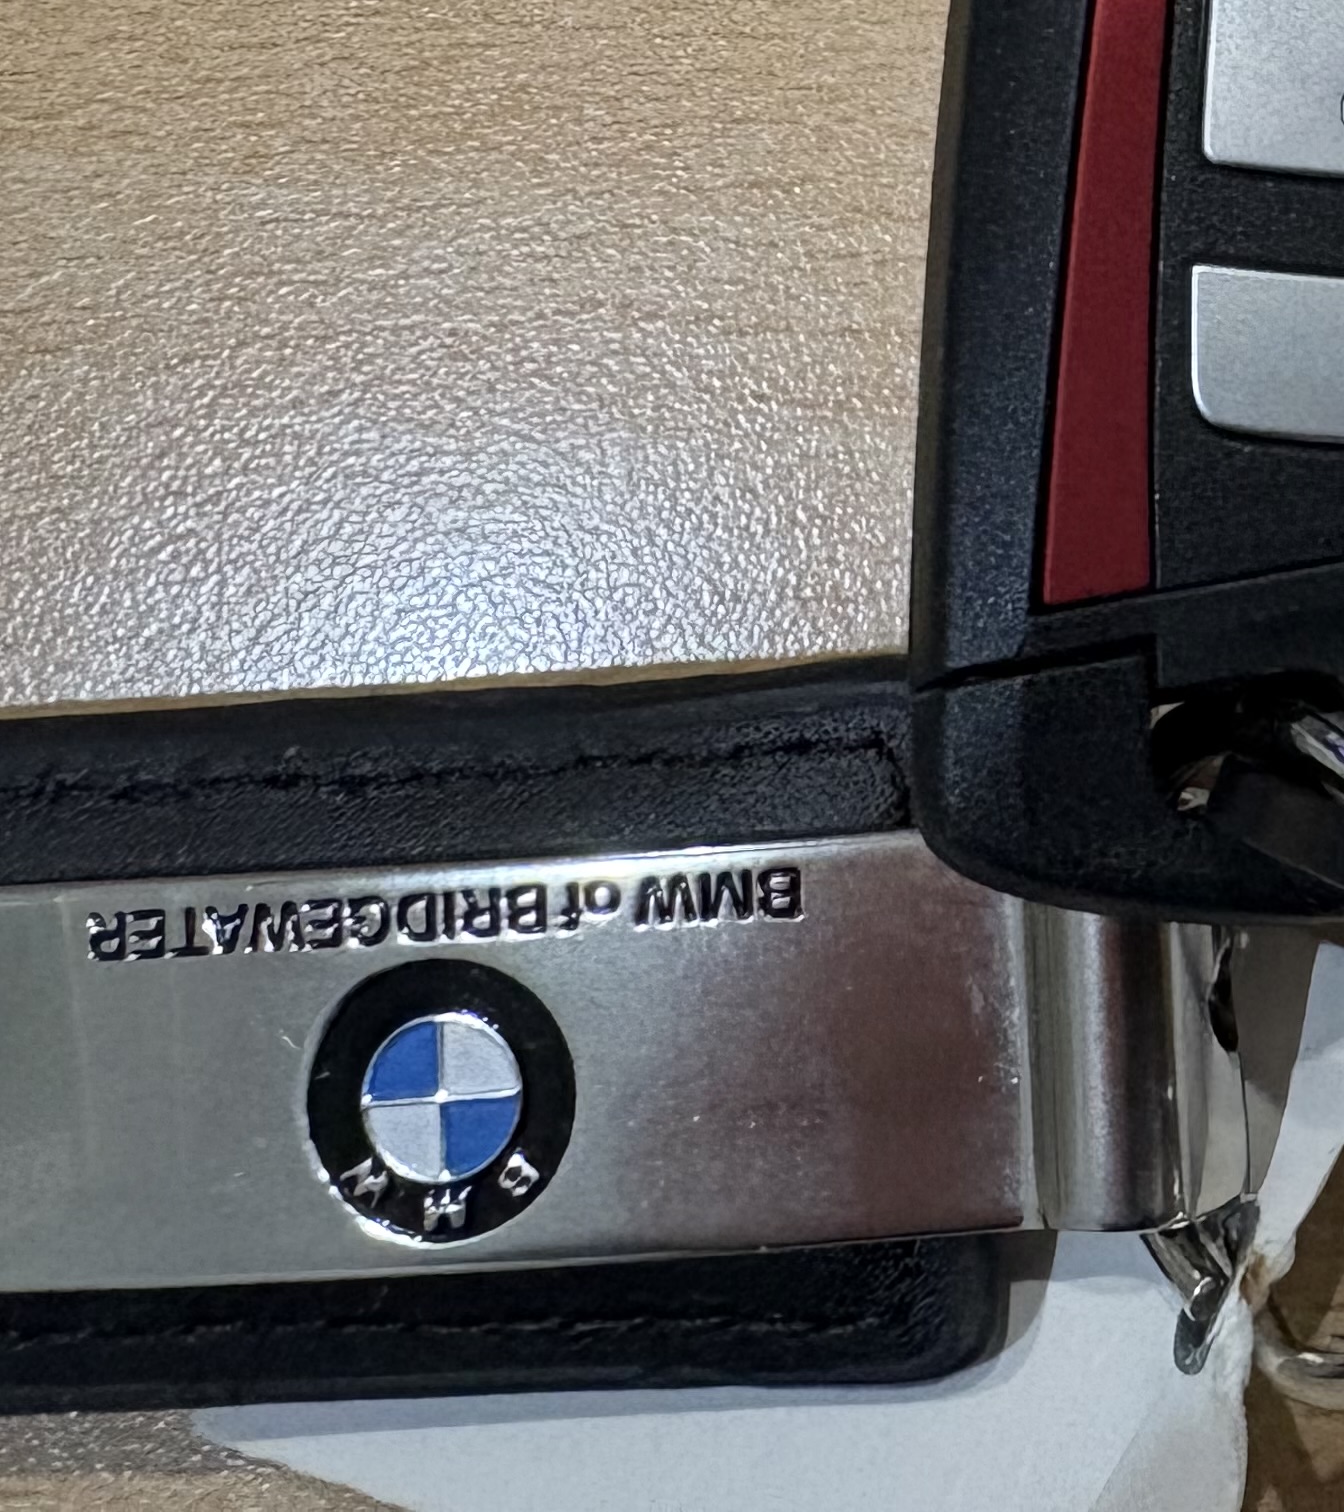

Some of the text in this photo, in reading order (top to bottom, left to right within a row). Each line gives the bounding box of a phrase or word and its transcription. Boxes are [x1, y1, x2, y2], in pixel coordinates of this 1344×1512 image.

[87, 867, 804, 961] BMW of BRIDGEWATER
[340, 1148, 540, 1231] BMW
